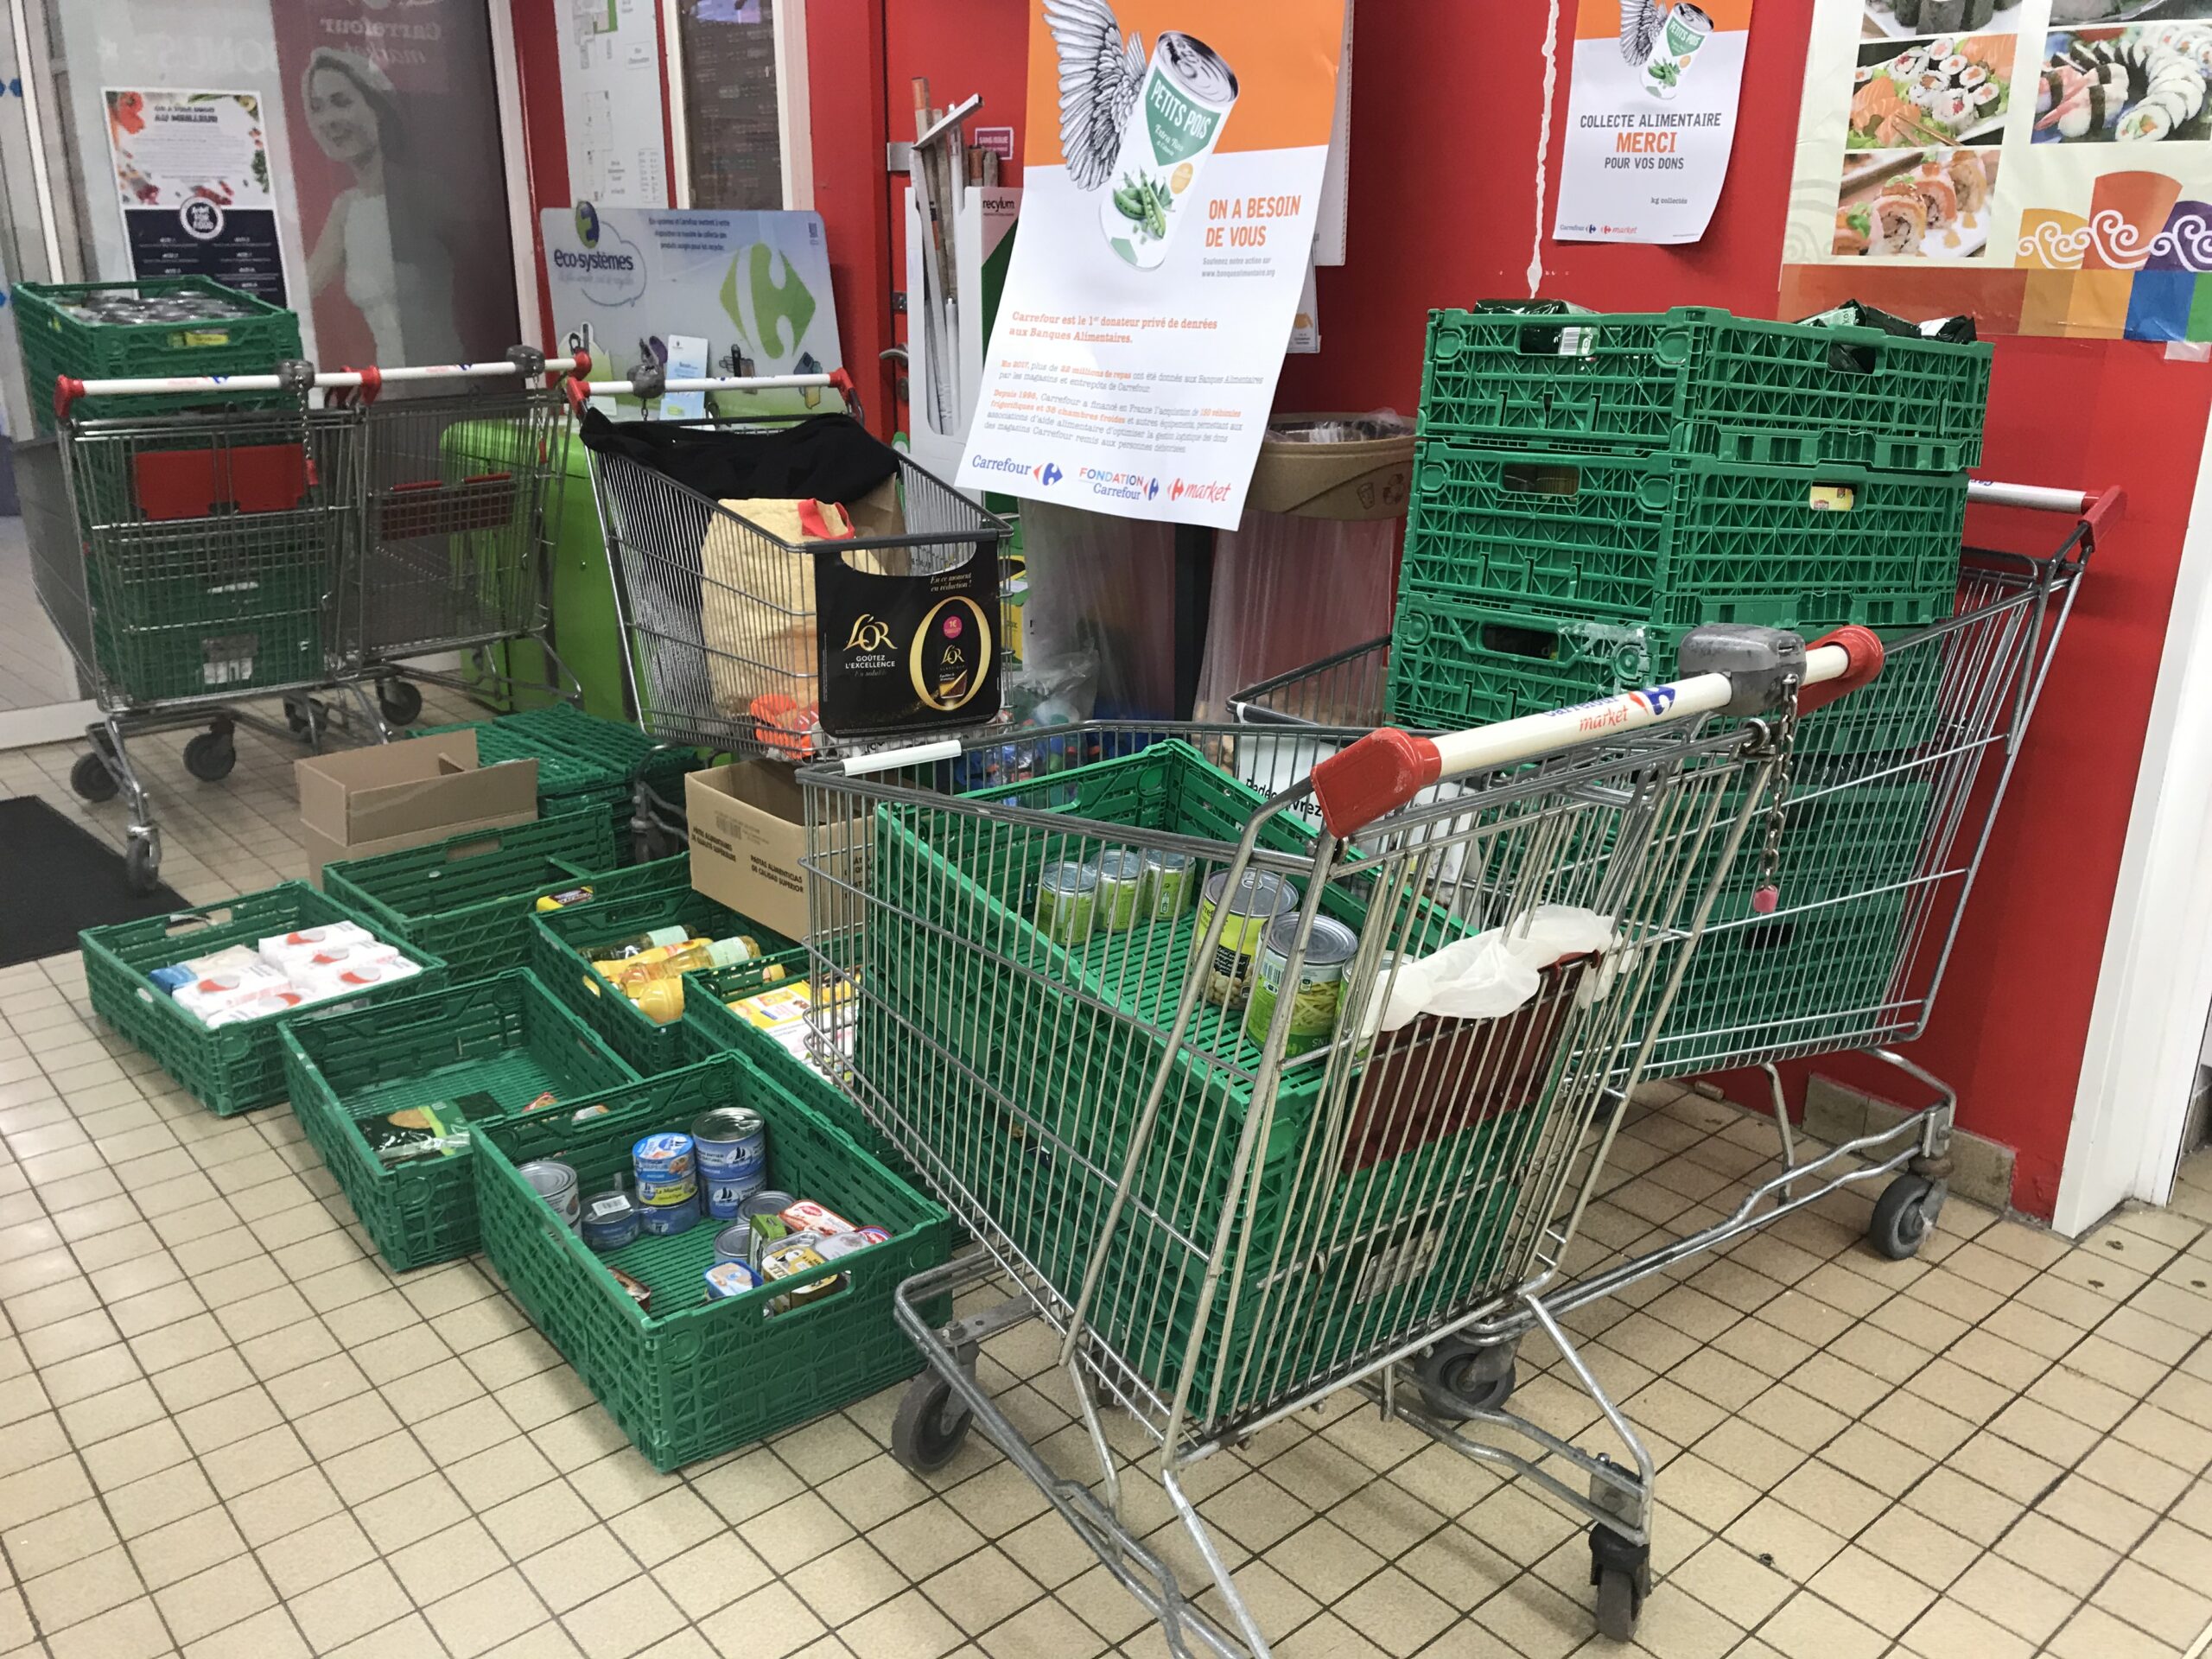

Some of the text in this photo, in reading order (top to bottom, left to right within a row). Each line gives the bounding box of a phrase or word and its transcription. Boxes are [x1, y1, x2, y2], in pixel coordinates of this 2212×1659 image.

[1151, 79, 1211, 139] PETITS POIS
[1580, 112, 1722, 129] COLLECTE ALIMENTAIRE
[1616, 131, 1677, 154] MERCI
[1605, 157, 1685, 170] POUR VOS DONS
[1209, 194, 1301, 220] ON A BESOIN
[1205, 226, 1268, 247] DE VOUS
[1012, 311, 1061, 325] Carrefour
[1062, 315, 1076, 325] est
[1077, 315, 1086, 326] le
[1100, 316, 1140, 327] donateur
[1141, 317, 1166, 329] privé
[1167, 317, 1179, 328] de
[1180, 318, 1217, 329] denrées
[972, 454, 1032, 476] Carrefour
[1079, 467, 1145, 488] FONDATION
[1092, 482, 1141, 501] Carrefour
[1185, 480, 1231, 503] market
[845, 660, 896, 670] L'EXCELLENCE
[1579, 705, 1630, 732] market
